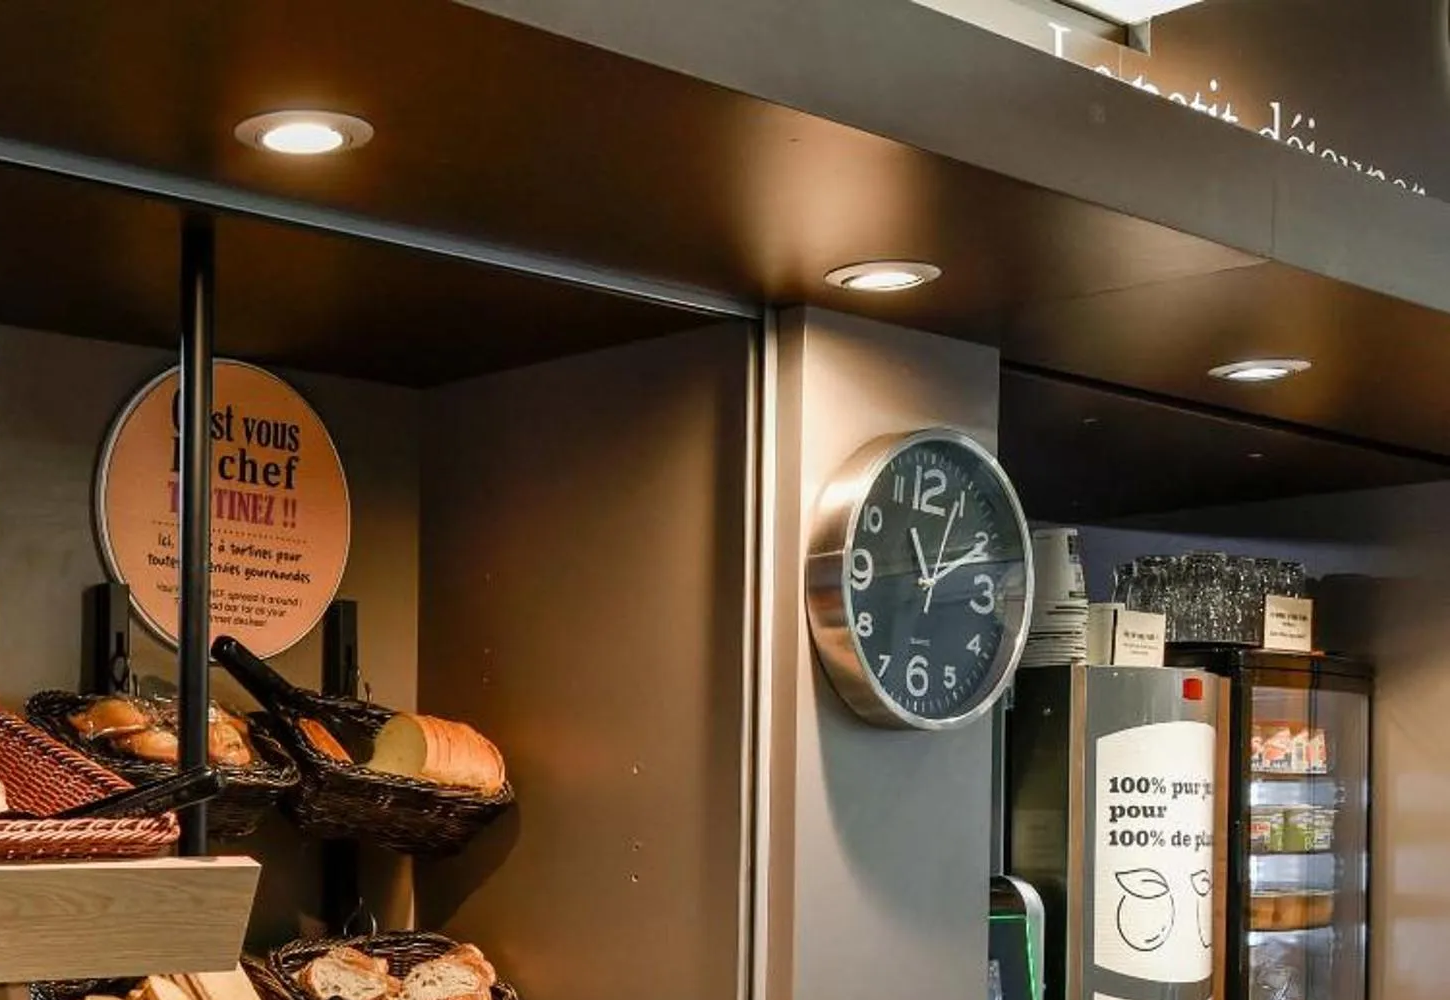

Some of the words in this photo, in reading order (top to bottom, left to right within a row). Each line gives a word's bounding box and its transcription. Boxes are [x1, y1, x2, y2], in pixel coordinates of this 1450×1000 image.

[243, 416, 300, 453] vous
[218, 448, 299, 490] chef
[167, 480, 276, 526] TTINEZ
[893, 476, 904, 503] 11
[912, 465, 947, 516] 12
[863, 505, 883, 534] 10
[850, 548, 873, 591] 9
[970, 574, 995, 614] 3
[856, 612, 873, 637] 8
[966, 633, 981, 657] 4
[877, 655, 891, 678] 7
[906, 655, 929, 697] 6
[943, 666, 957, 689] 5
[1109, 776, 1167, 794] 100%
[1171, 781, 1200, 799] pur
[1109, 804, 1167, 823] pour
[1108, 829, 1166, 847] 100%
[1171, 830, 1192, 847] de
